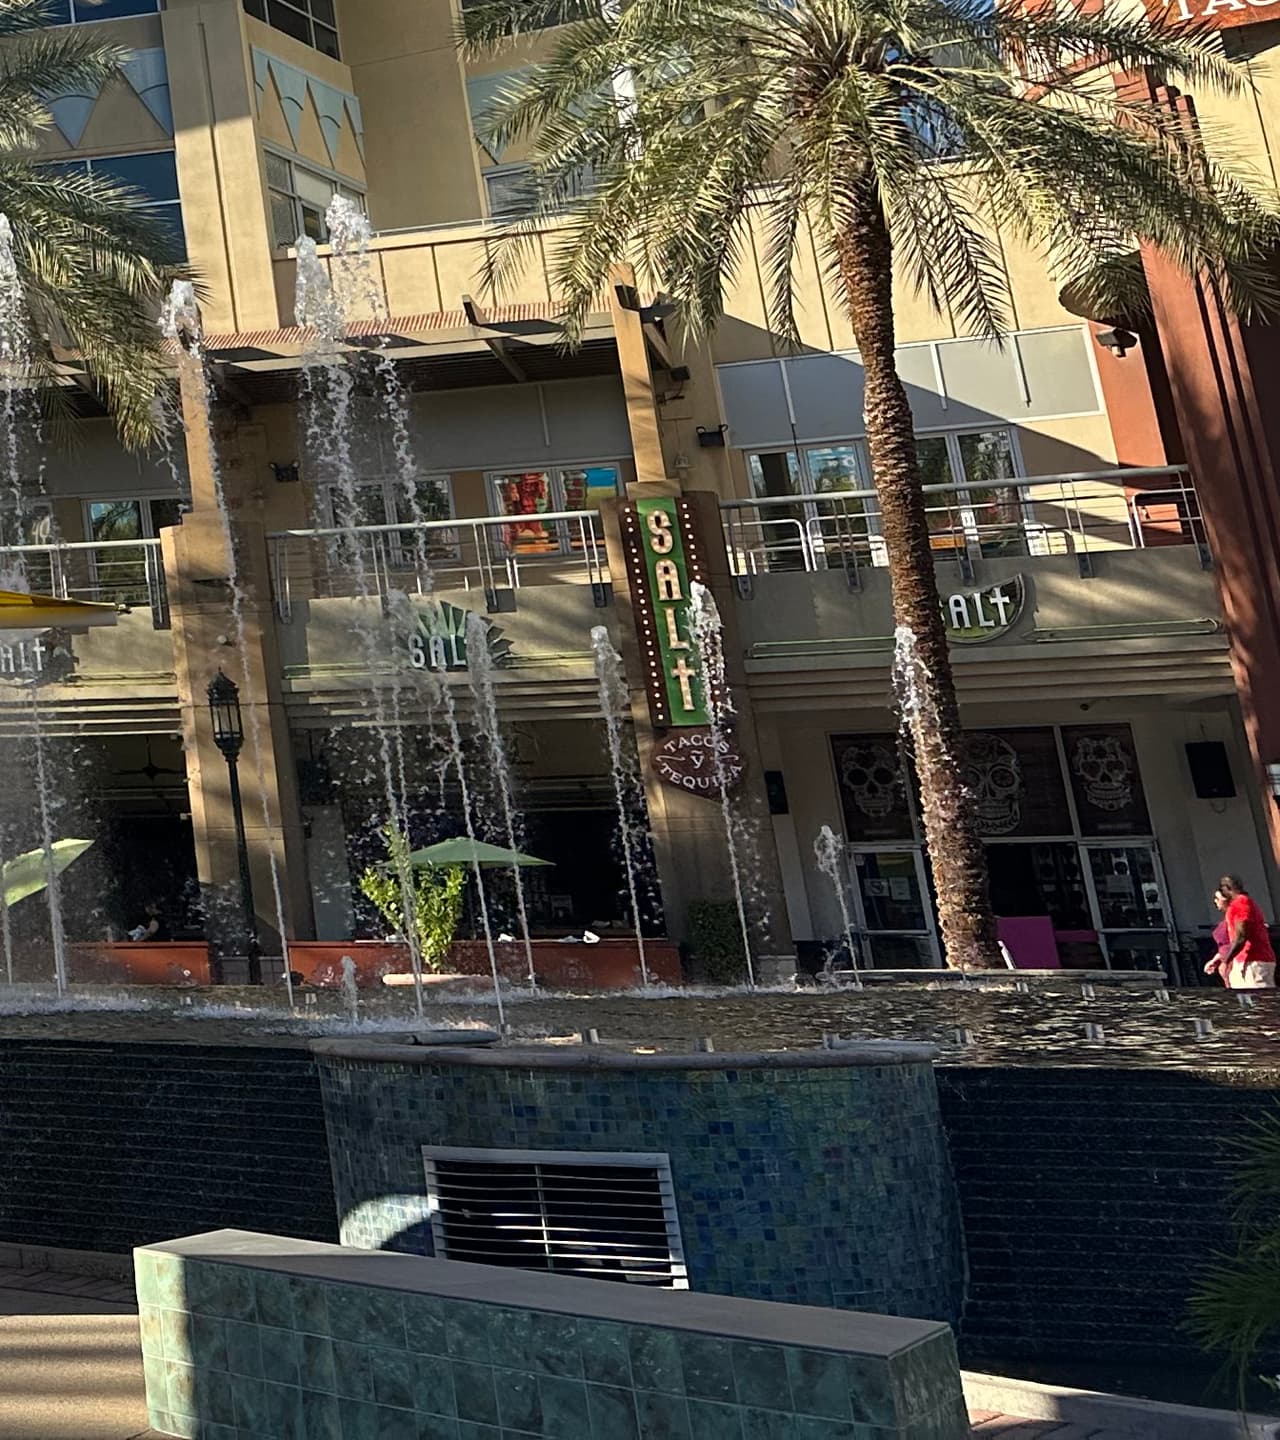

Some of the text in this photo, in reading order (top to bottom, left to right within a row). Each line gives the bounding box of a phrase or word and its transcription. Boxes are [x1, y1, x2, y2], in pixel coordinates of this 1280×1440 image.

[646, 510, 696, 711] SALT
[939, 587, 1010, 629] ALT
[408, 634, 469, 668] SAL
[664, 735, 730, 753] TACOS
